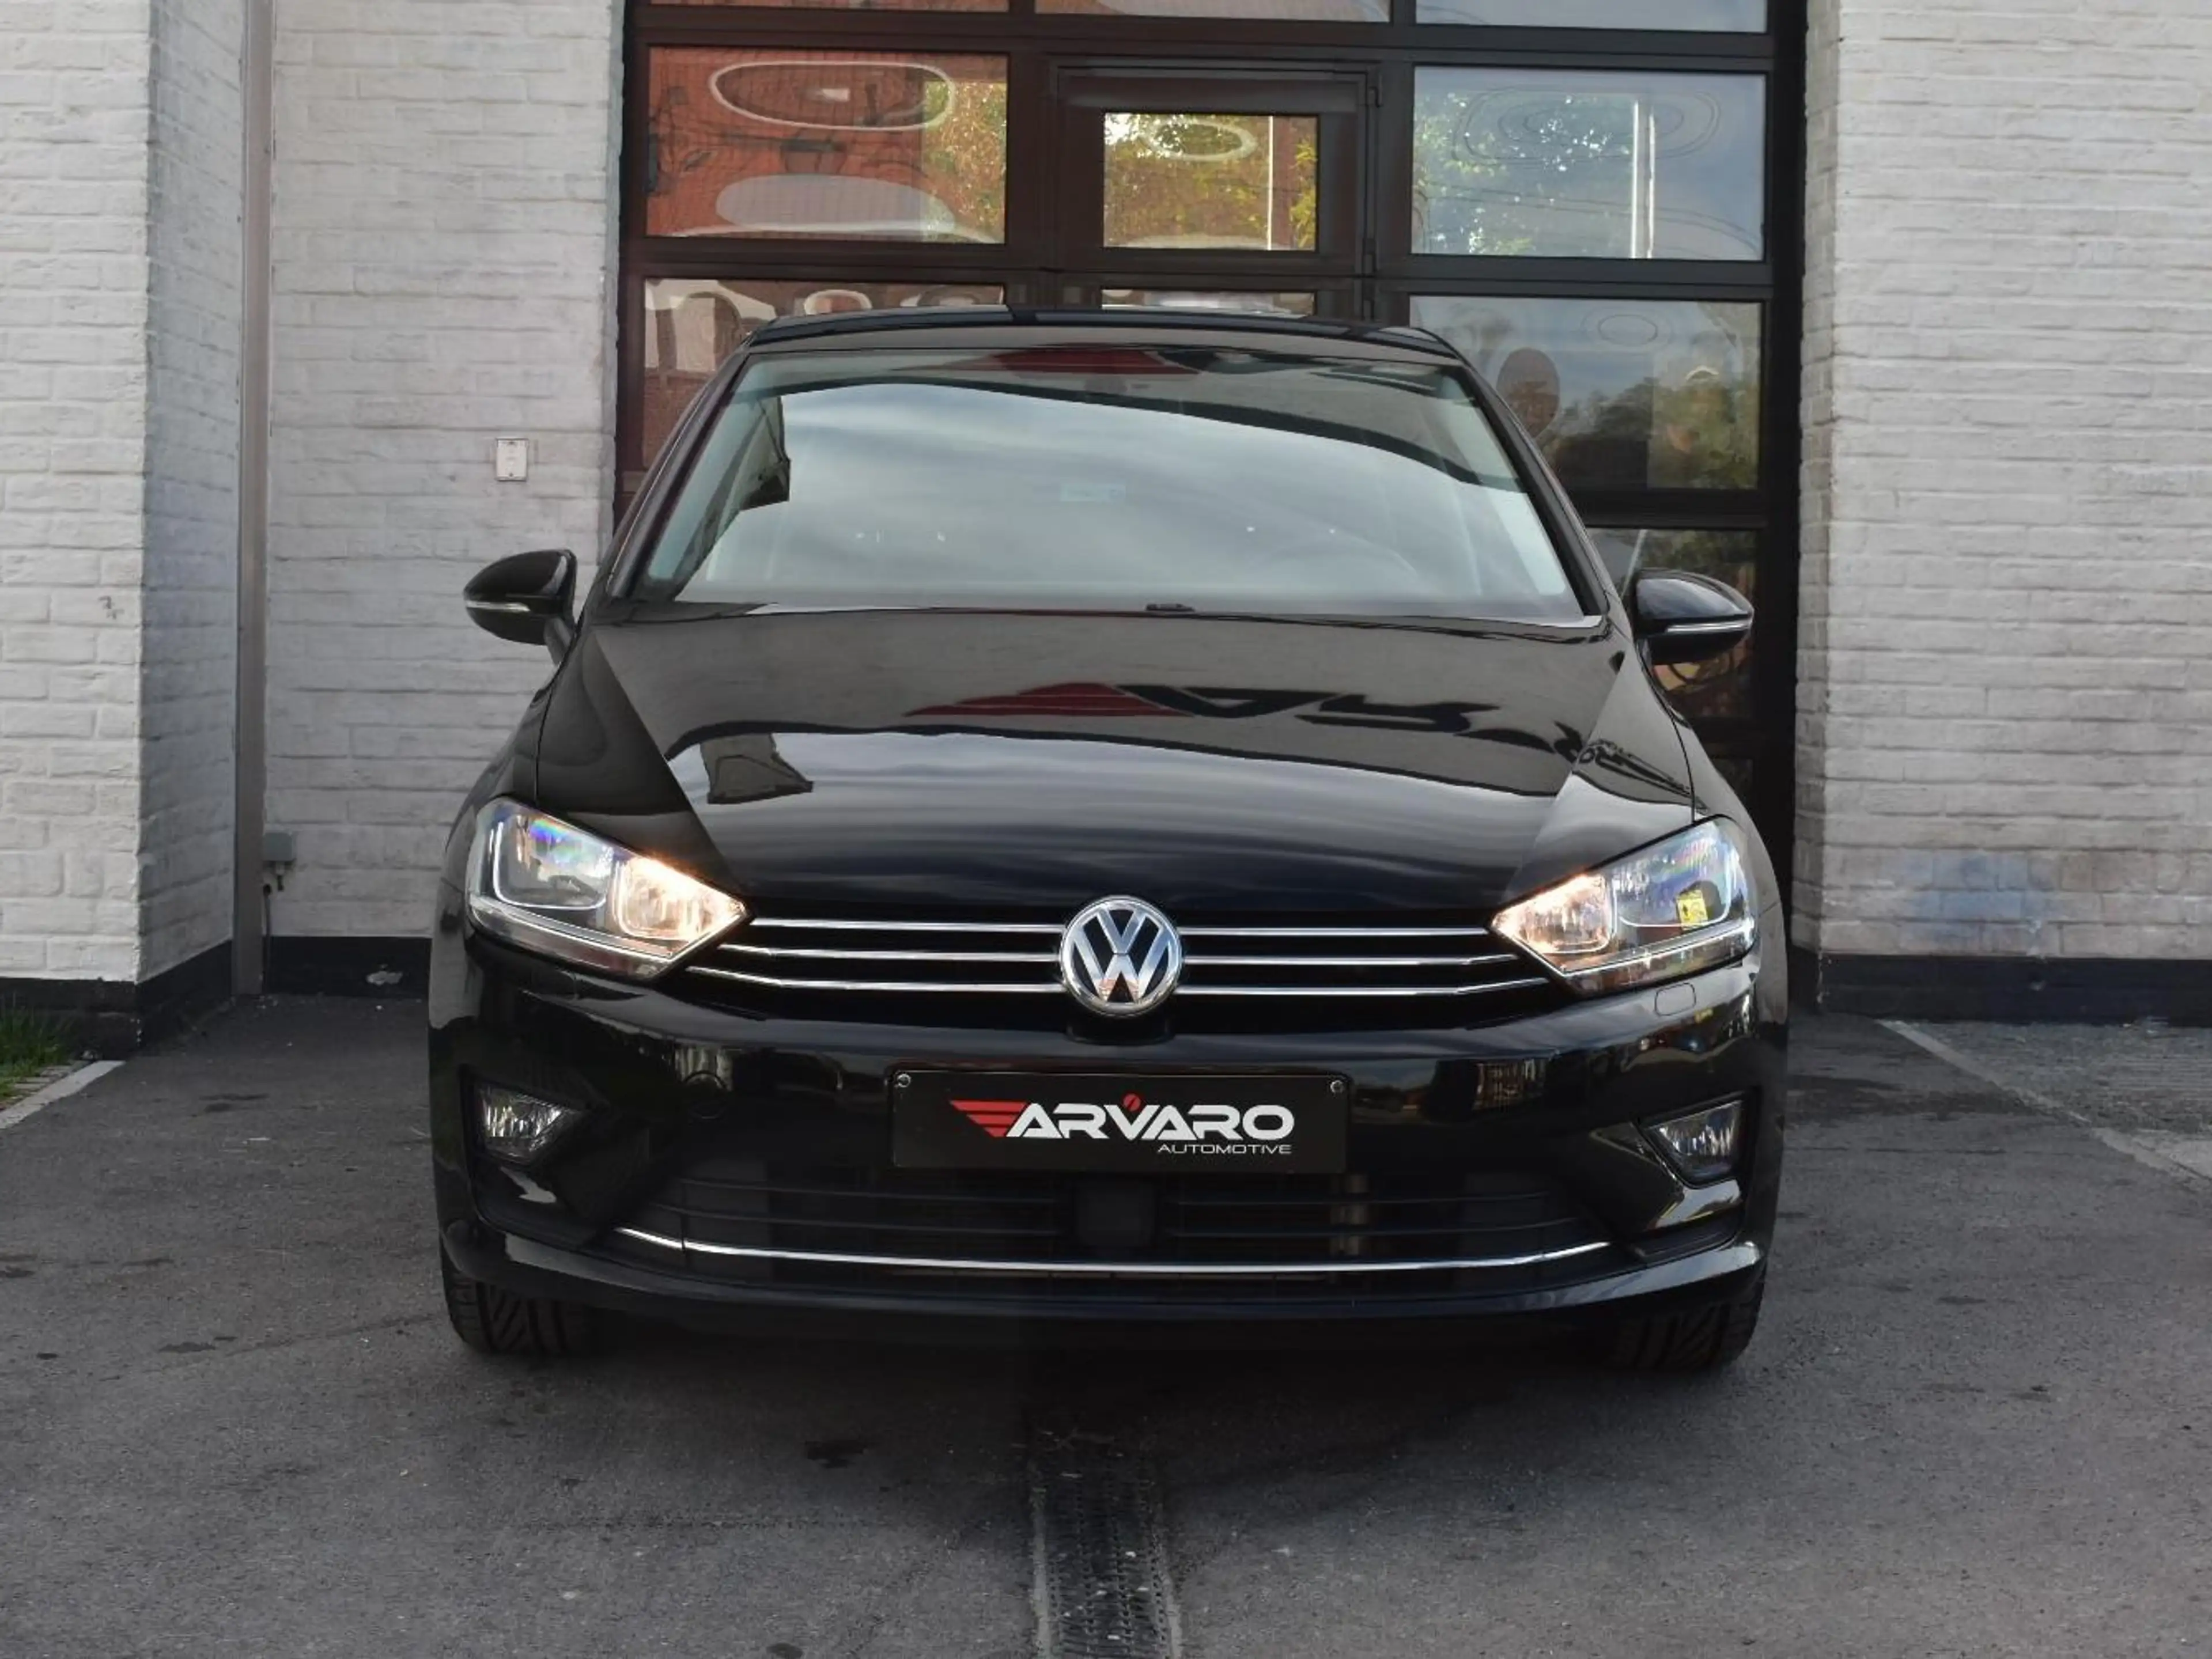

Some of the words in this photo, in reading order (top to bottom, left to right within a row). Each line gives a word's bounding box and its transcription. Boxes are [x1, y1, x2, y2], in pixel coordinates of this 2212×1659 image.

[1066, 899, 1175, 1007] VW
[1006, 1103, 1295, 1141] ARVARO
[1158, 1144, 1291, 1154] AUTOMOTIVE
